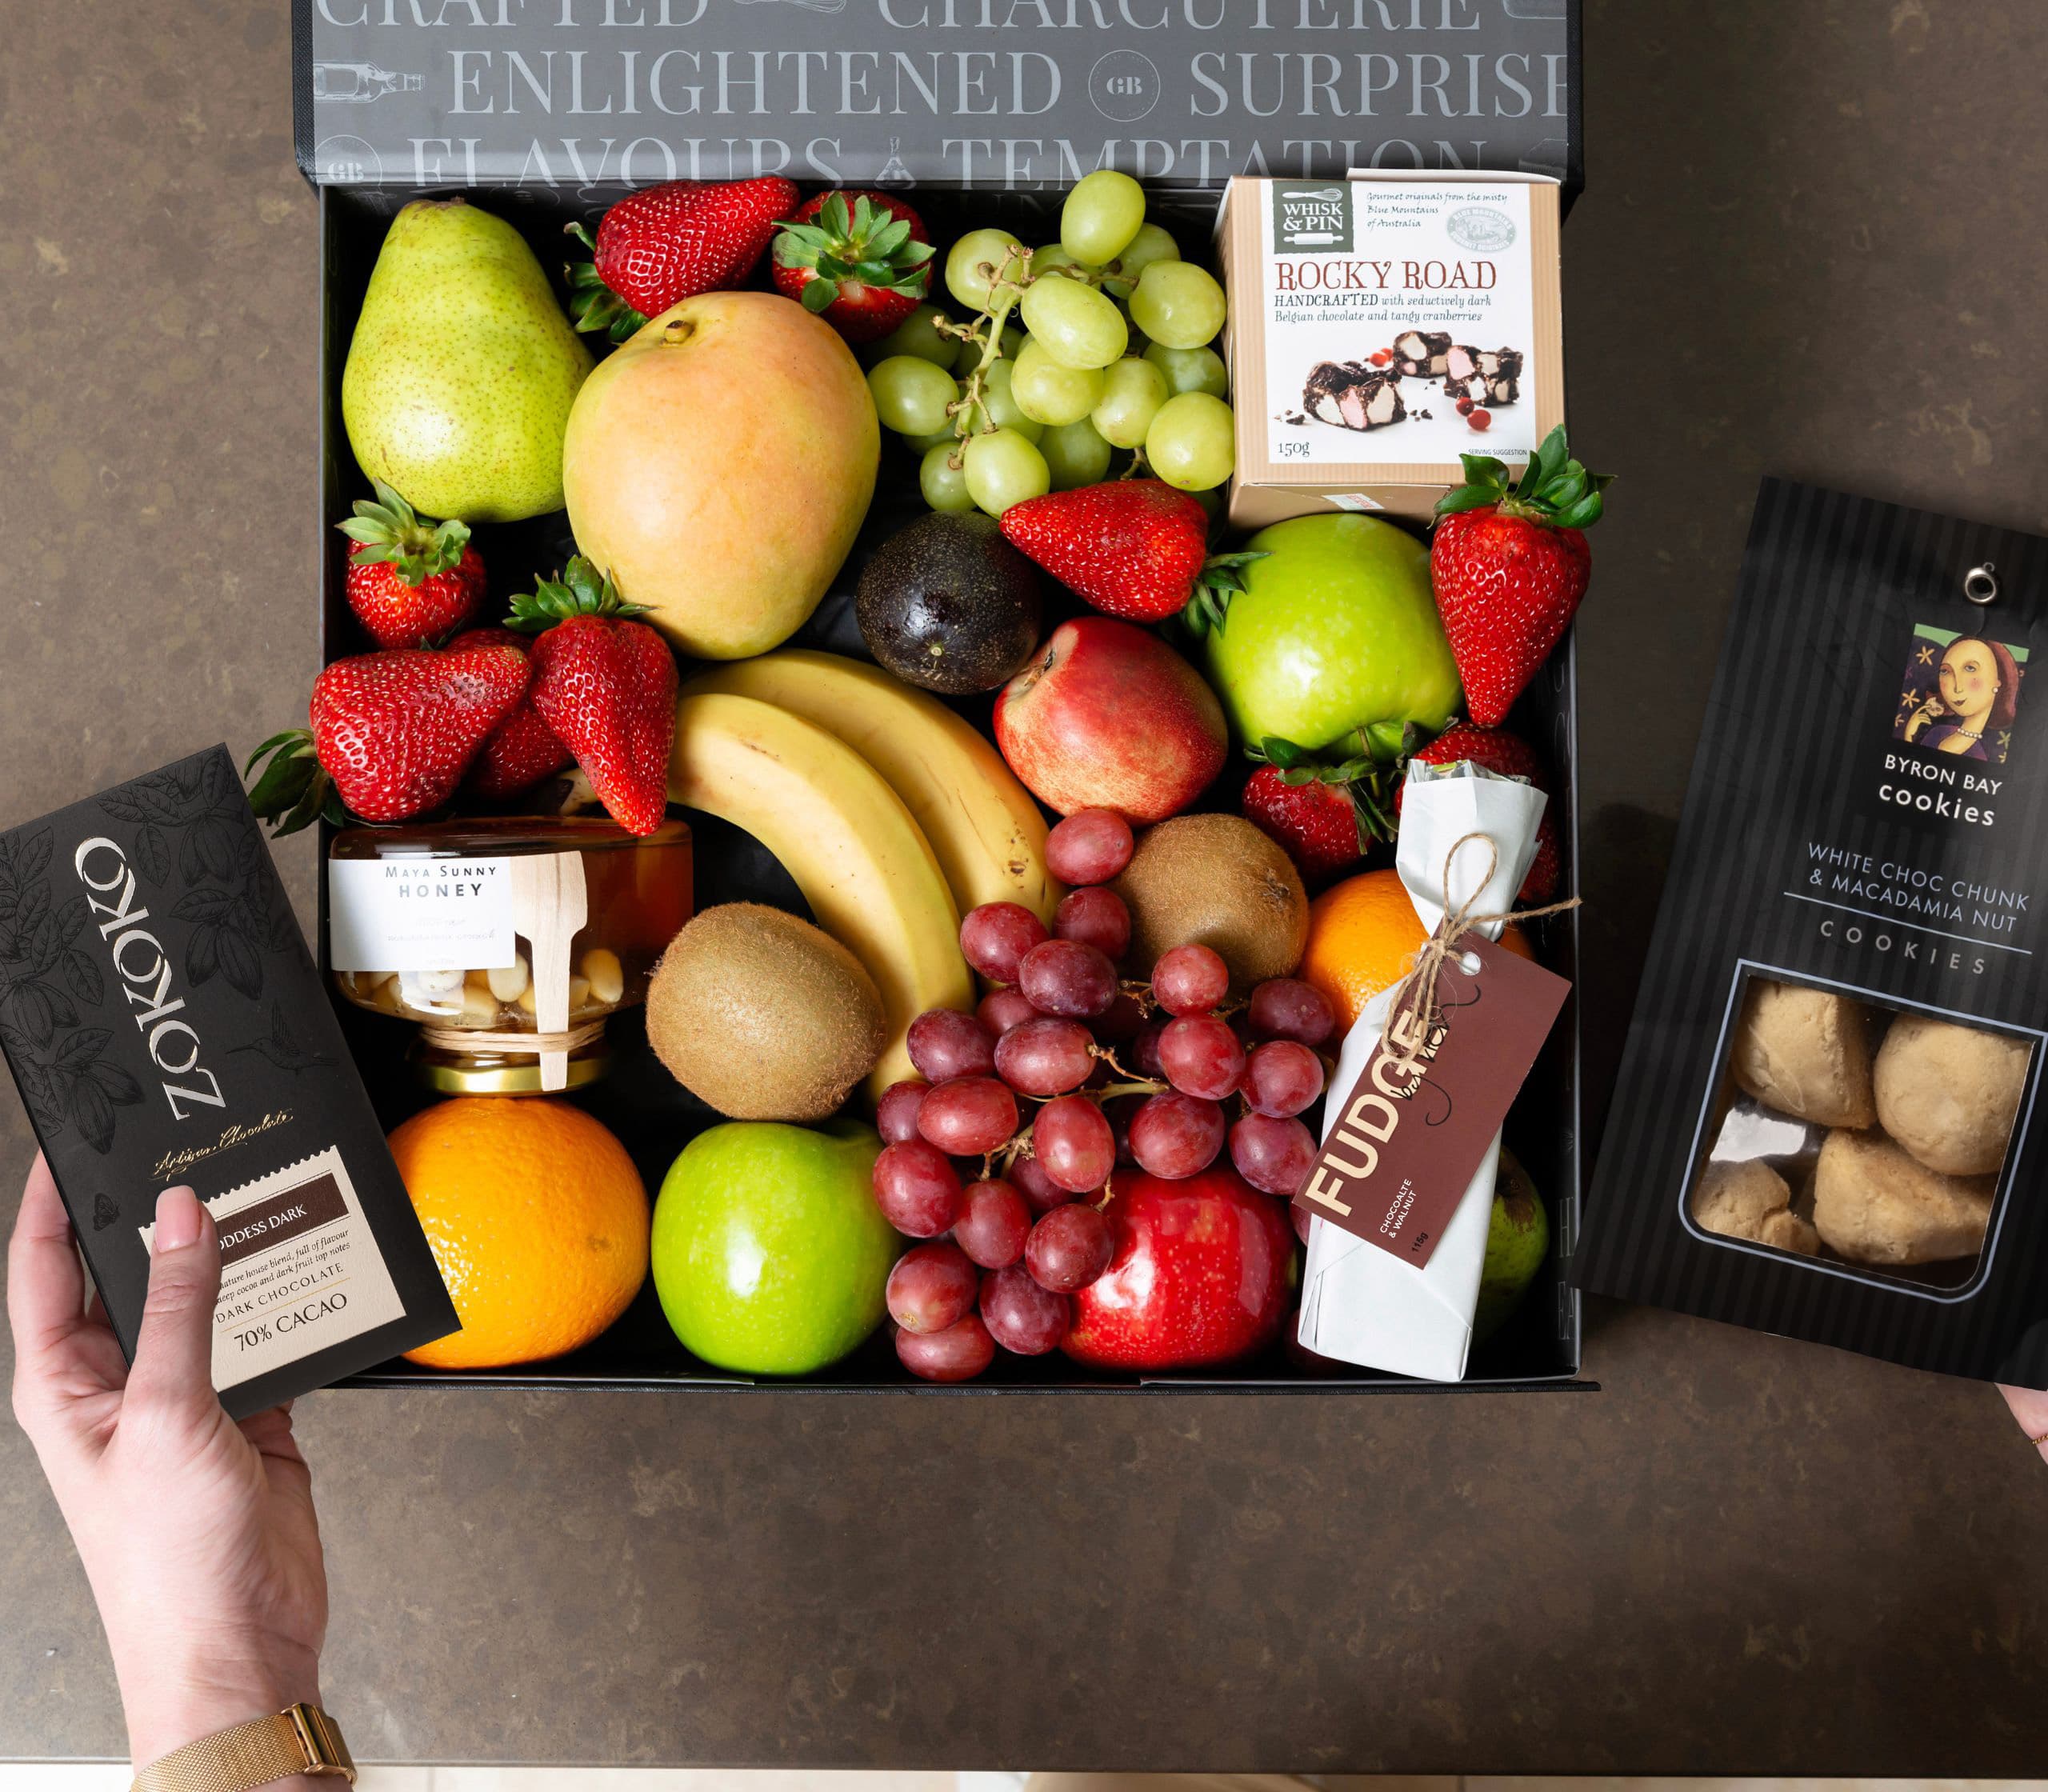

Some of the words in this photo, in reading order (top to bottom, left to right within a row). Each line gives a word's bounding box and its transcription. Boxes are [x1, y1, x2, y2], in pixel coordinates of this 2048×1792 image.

[446, 50, 1062, 115] ENLIGHTENED
[1106, 76, 1143, 95] GB
[1282, 202, 1344, 216] WHISK
[1366, 192, 1403, 203] Gourmet
[1405, 192, 1442, 204] originals
[1443, 192, 1465, 205] from
[1466, 192, 1481, 202] the
[1482, 193, 1507, 206] misty
[1367, 205, 1389, 214] Blue
[1390, 205, 1439, 214] Mountains
[1283, 216, 1303, 231] &
[1304, 216, 1344, 230] PIN
[1366, 218, 1377, 232] of
[1377, 218, 1422, 227] Australia
[1274, 260, 1392, 291] ROCKY
[1401, 260, 1498, 290] ROAD
[1274, 293, 1378, 307] HANDCRAFTED
[1381, 294, 1406, 306] with
[1407, 294, 1466, 309] seductively
[1467, 294, 1492, 306] dark
[1274, 310, 1314, 325] Belgian
[1316, 310, 1365, 322] chocolate
[1366, 310, 1388, 322] and
[1390, 310, 1420, 324] tangy
[1422, 310, 1483, 322] cranberries
[1278, 441, 1310, 458] 150g
[1884, 754, 1956, 786] BYRON
[1962, 774, 2002, 796] BAY
[1878, 783, 1995, 826] cookies
[398, 882, 482, 898] HONEY
[1808, 842, 1874, 874] WHITE
[1880, 862, 1943, 892] CHOC
[1950, 880, 2030, 912] CHUNK
[1809, 868, 1823, 886] &
[1831, 873, 1963, 922] MACADAMIA
[1972, 909, 2017, 933] NUT
[1820, 920, 1986, 975] COOKIES
[74, 836, 227, 1122] ZOKOKO
[218, 1110, 294, 1149] Chocolate
[1304, 1008, 1450, 1218] FUDGE
[1379, 1178, 1413, 1234] CHOCOALTE
[1392, 1190, 1418, 1230] WALNUT
[219, 1220, 267, 1251] DDESS
[268, 1203, 308, 1230] DARK
[1411, 1231, 1430, 1253] 115g
[237, 1282, 258, 1296] cocoa
[259, 1272, 275, 1286] and
[276, 1265, 294, 1280] dark
[295, 1257, 314, 1274] fruit
[314, 1251, 328, 1262] top
[330, 1241, 350, 1256] notes
[245, 1264, 269, 1279] house
[269, 1251, 294, 1269] blend,
[295, 1244, 310, 1260] full
[311, 1238, 321, 1252] of
[320, 1229, 350, 1250] flavour
[214, 1299, 254, 1324] DARK
[257, 1262, 344, 1306] CHOCOLATE
[233, 1323, 274, 1352] 70%
[276, 1292, 348, 1333] CACAO
